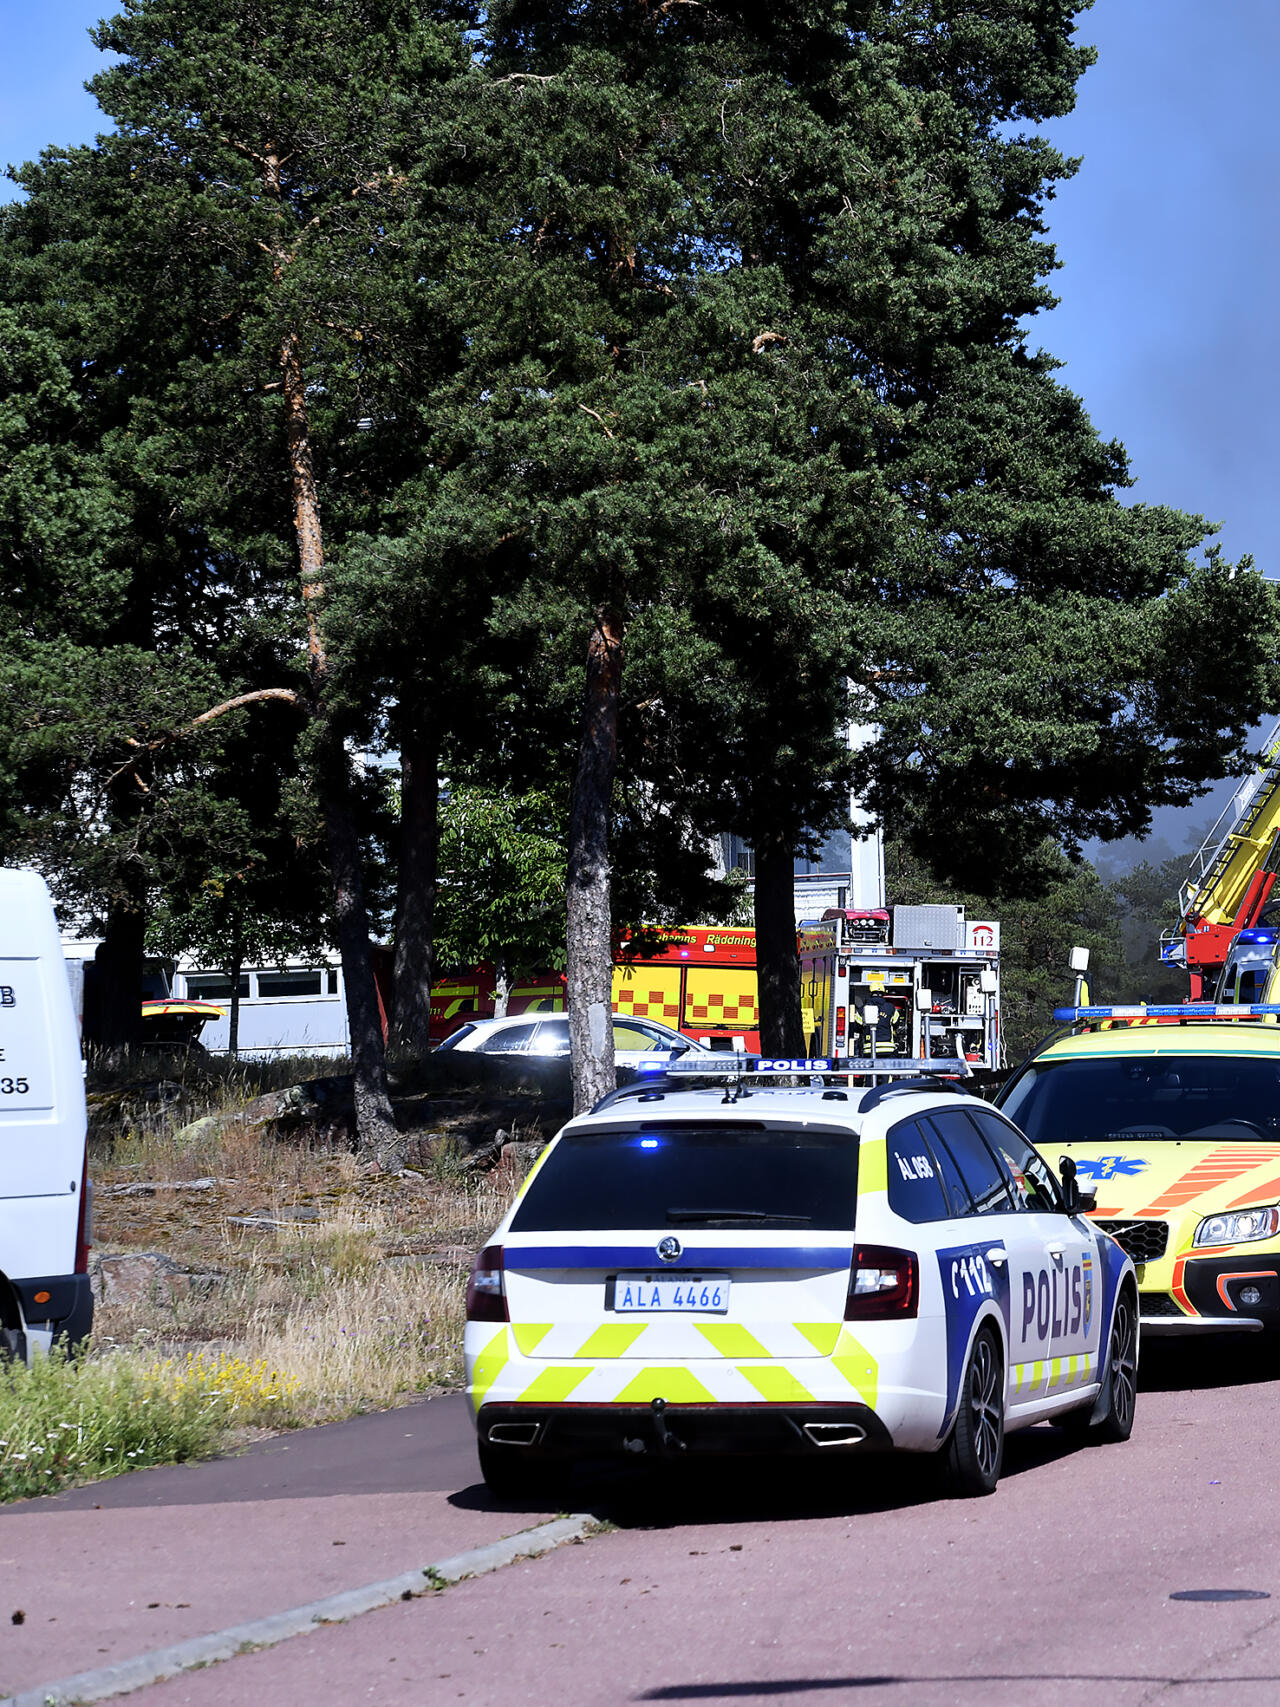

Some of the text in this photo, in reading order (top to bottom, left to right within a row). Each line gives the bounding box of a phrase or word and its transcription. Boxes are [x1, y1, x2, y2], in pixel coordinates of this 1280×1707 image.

[973, 935, 993, 947] 112
[758, 1060, 828, 1070] POLIS
[1, 1077, 29, 1094] 35
[959, 1255, 993, 1296] 112
[673, 1286, 721, 1307] 4466
[1022, 1265, 1082, 1343] POLIS
